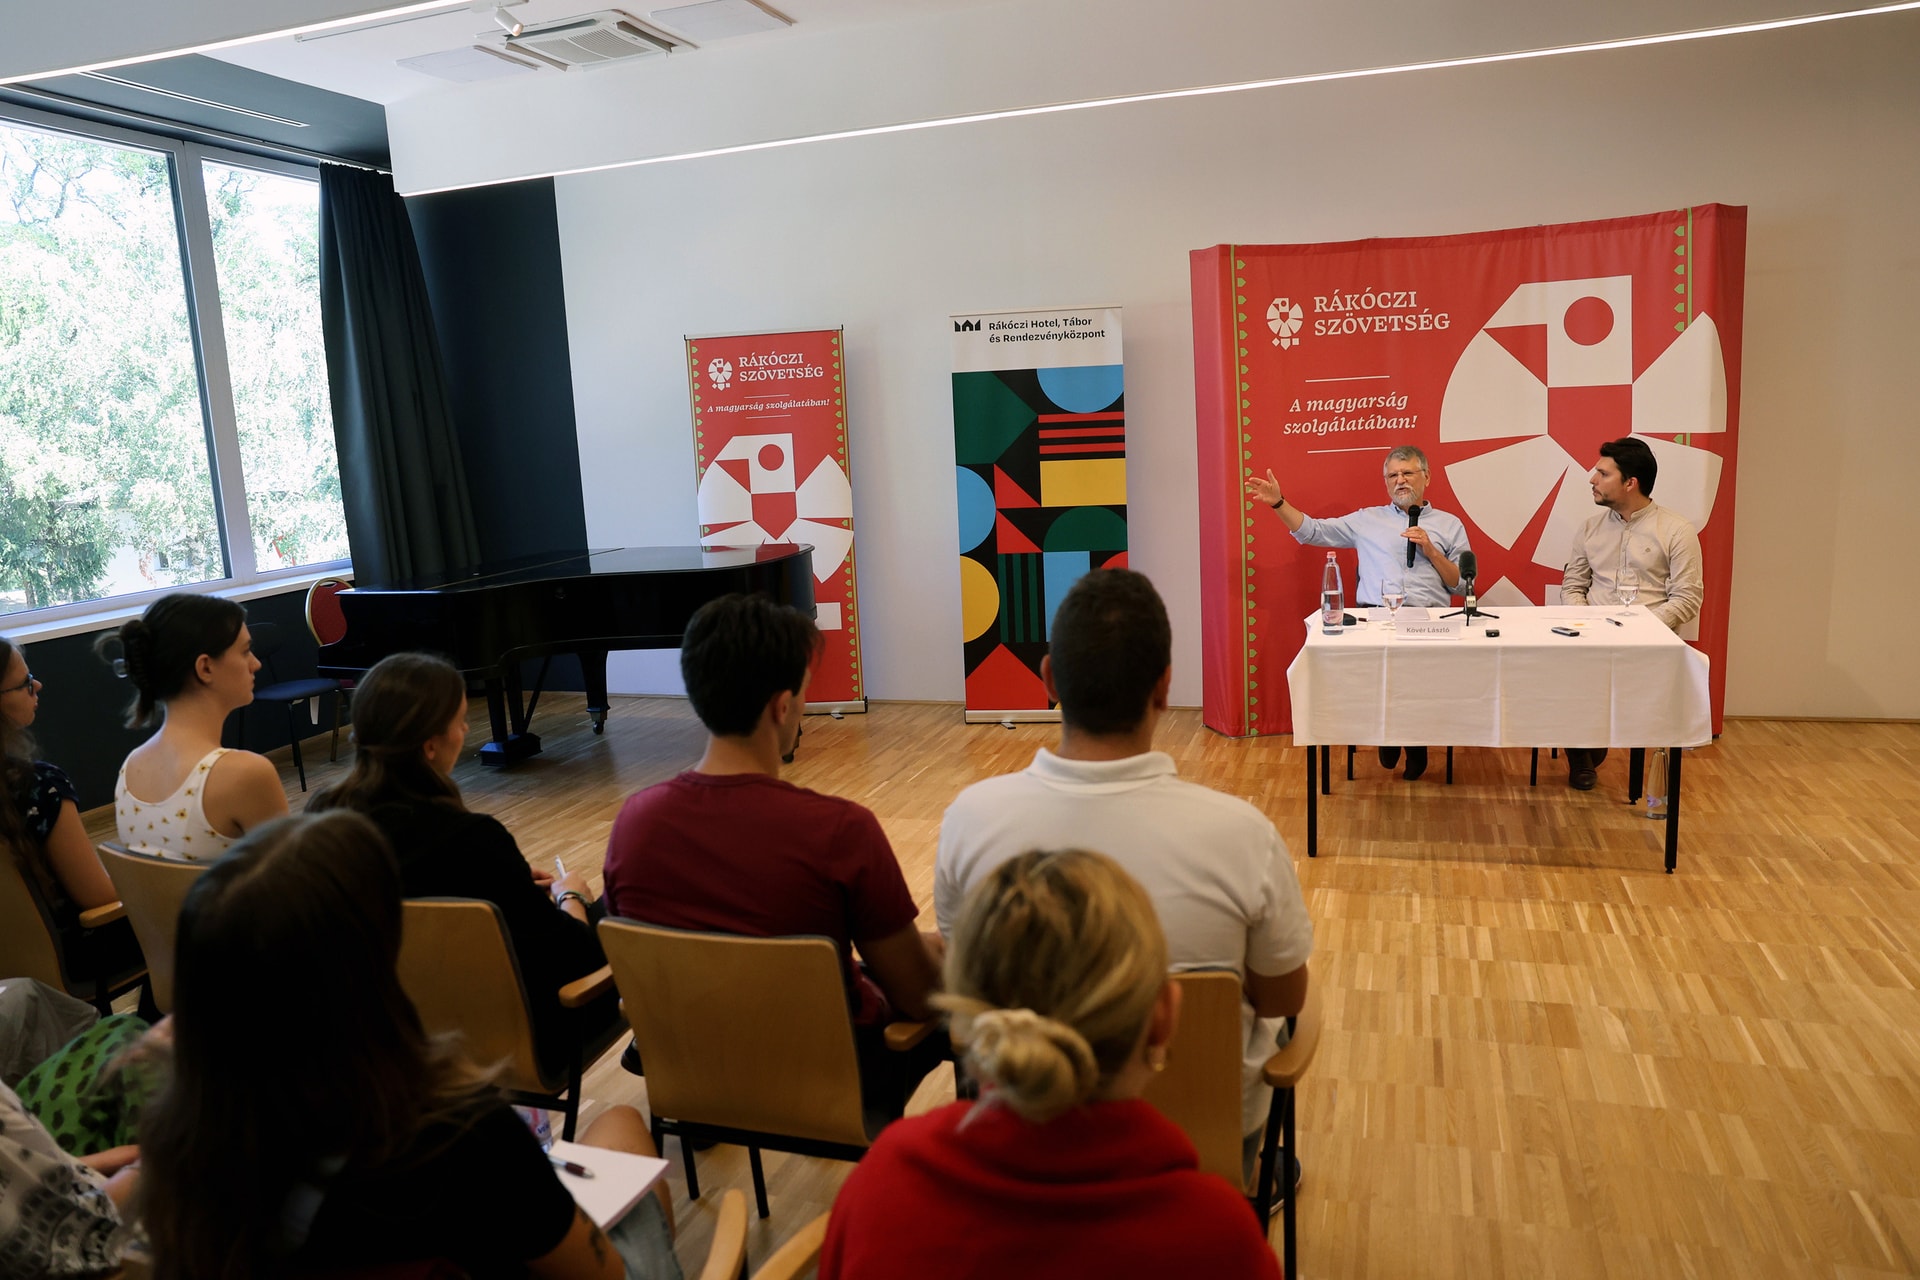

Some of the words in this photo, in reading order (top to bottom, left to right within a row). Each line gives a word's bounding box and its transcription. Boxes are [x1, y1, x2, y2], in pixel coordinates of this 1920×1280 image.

[1314, 287, 1417, 313] RÁKÓCZI
[989, 320, 1028, 331] Rákóczi
[1031, 318, 1061, 329] Hotel,
[1063, 317, 1092, 327] Tábor
[1314, 308, 1450, 336] SZÖVETSÉG
[989, 334, 1000, 343] és
[1003, 329, 1105, 342] Rendezvényközpont
[739, 351, 804, 368] RÁKÓCZI
[739, 364, 824, 382] SZÖVETSÉG
[707, 405, 714, 413] A
[715, 401, 763, 413] magyarság
[765, 399, 830, 410] szolgálatában!
[1289, 399, 1301, 412] A
[1306, 392, 1408, 413] magyarság
[1283, 415, 1417, 436] szolgálatában!
